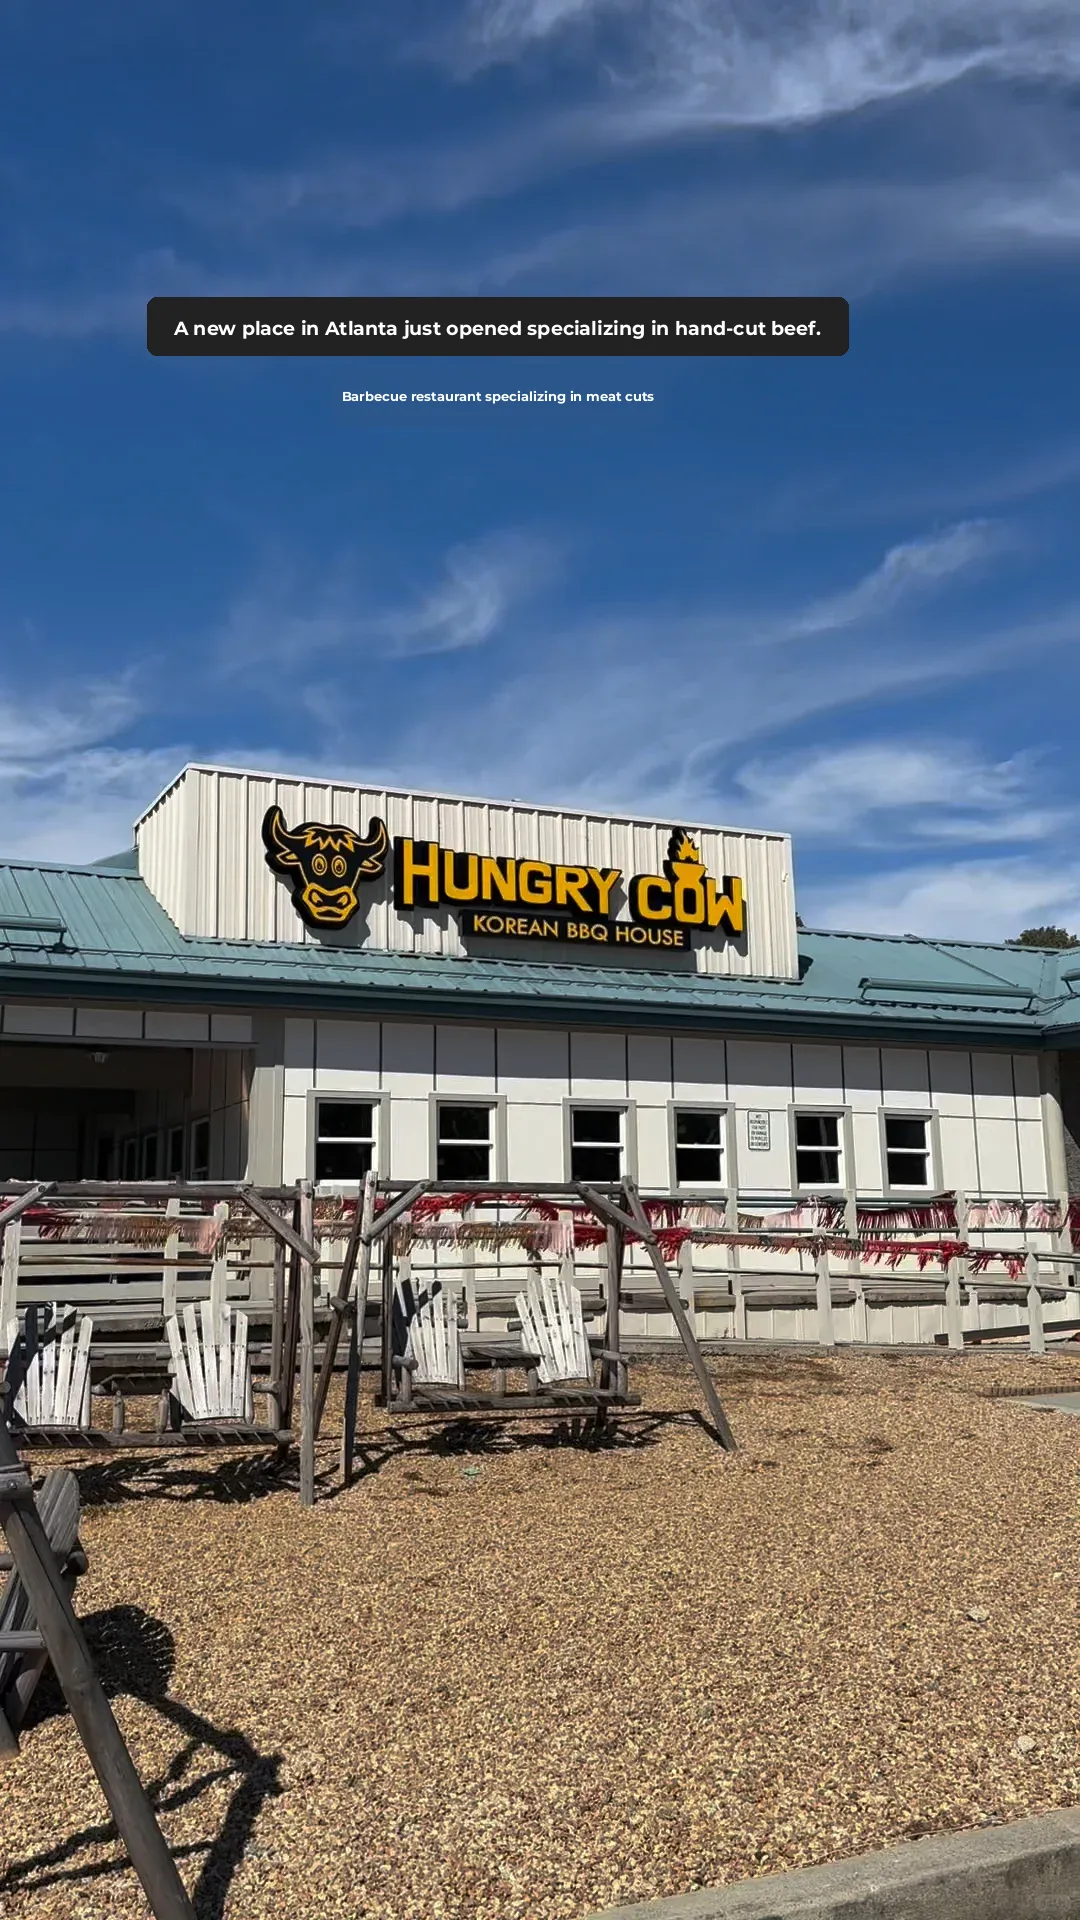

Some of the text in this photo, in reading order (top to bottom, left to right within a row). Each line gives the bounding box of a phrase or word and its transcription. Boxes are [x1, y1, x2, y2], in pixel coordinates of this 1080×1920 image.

[403, 839, 744, 932] HUNGRY COW
[473, 914, 684, 946] KOREAN BBQ HOUSE
